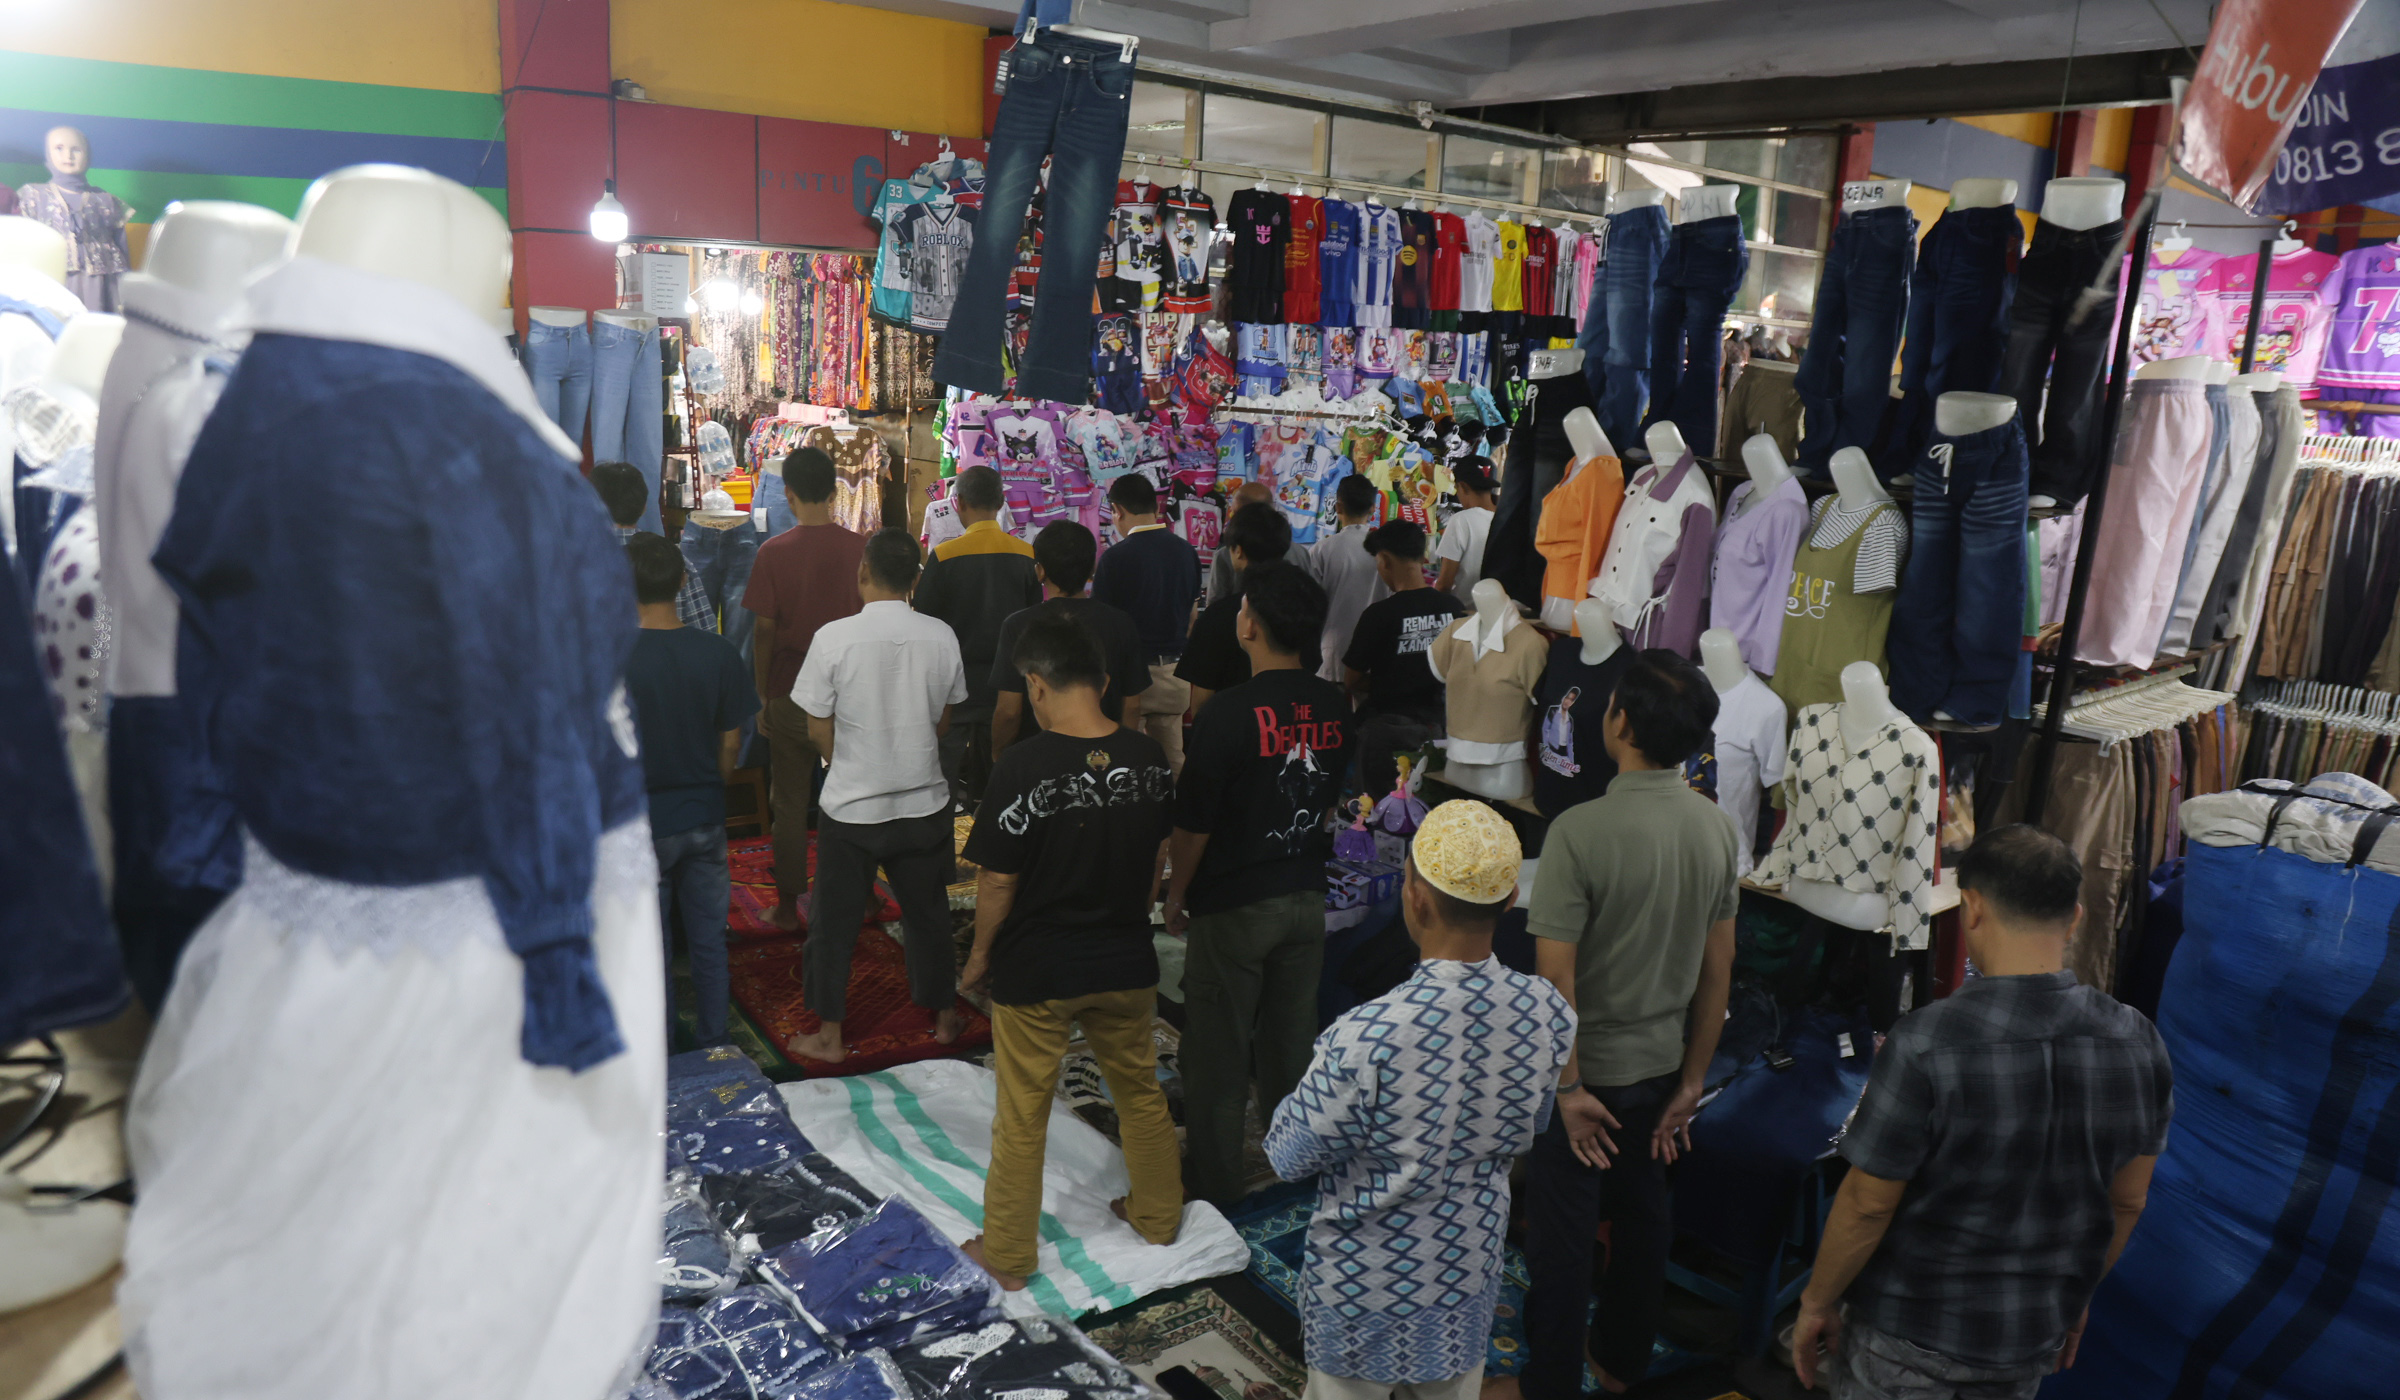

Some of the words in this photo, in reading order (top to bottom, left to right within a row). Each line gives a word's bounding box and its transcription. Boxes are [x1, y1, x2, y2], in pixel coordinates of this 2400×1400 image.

[2274, 140, 2364, 185] 0813
[852, 154, 884, 217] 6
[889, 184, 903, 198] 33
[922, 234, 966, 247] ROBLOX
[2349, 287, 2400, 353] 7
[1402, 612, 1454, 633] REMAJA
[1398, 637, 1437, 654] KAMP
[1291, 702, 1313, 720] THE
[1253, 706, 1343, 760] BEATLES
